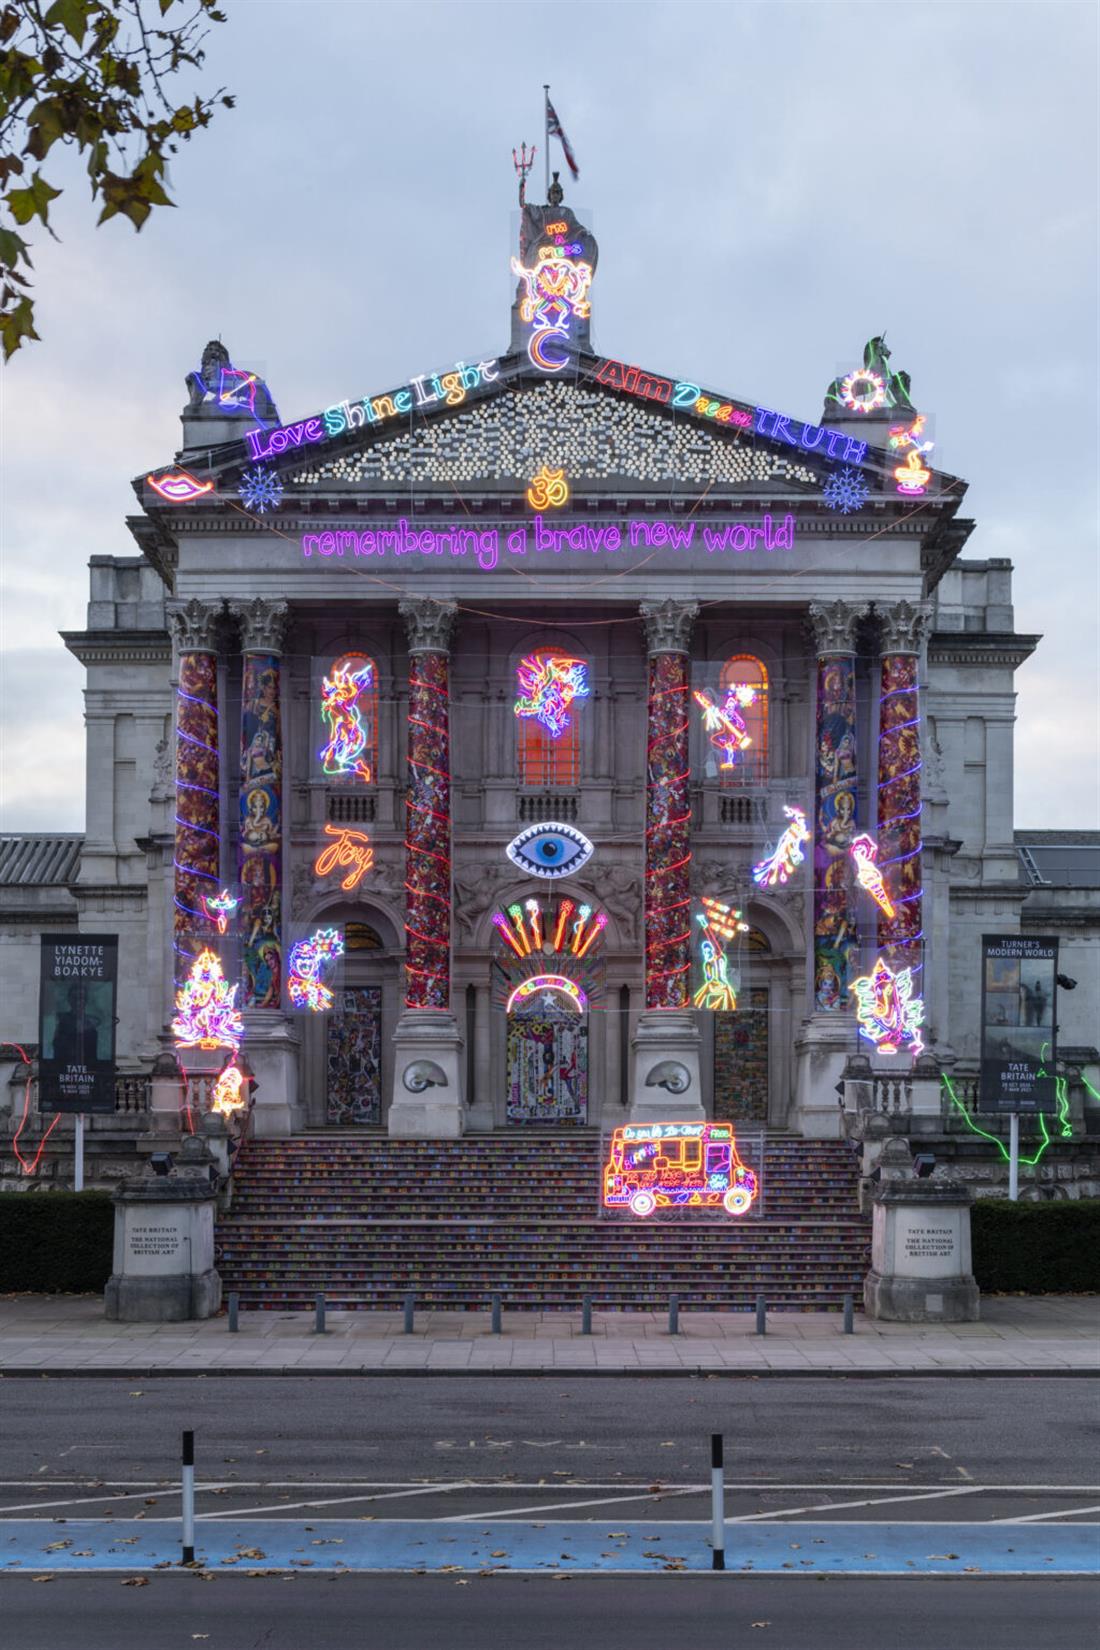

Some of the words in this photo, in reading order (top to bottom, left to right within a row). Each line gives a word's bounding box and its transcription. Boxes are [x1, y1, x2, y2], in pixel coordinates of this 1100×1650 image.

[246, 417, 323, 461] Love
[323, 390, 412, 436] Shine
[410, 360, 498, 405] Light
[596, 360, 672, 402] Aim
[673, 383, 752, 427] Dream
[755, 405, 868, 464] TRUTH
[303, 519, 498, 569] remembering
[508, 529, 527, 554] a
[535, 515, 621, 552] brave
[630, 519, 696, 549] new
[703, 514, 795, 551] world
[315, 824, 374, 890] Joy
[1001, 940, 1040, 948] TURNER'S
[55, 945, 104, 955] LYNETTE
[1025, 949, 1054, 957] WORLD
[54, 967, 104, 976] BOAKYE
[66, 1065, 88, 1073] TATE
[1008, 1063, 1029, 1072] TATE
[59, 1074, 95, 1083] BRITAIN
[1001, 1072, 1036, 1081] BRITAIN
